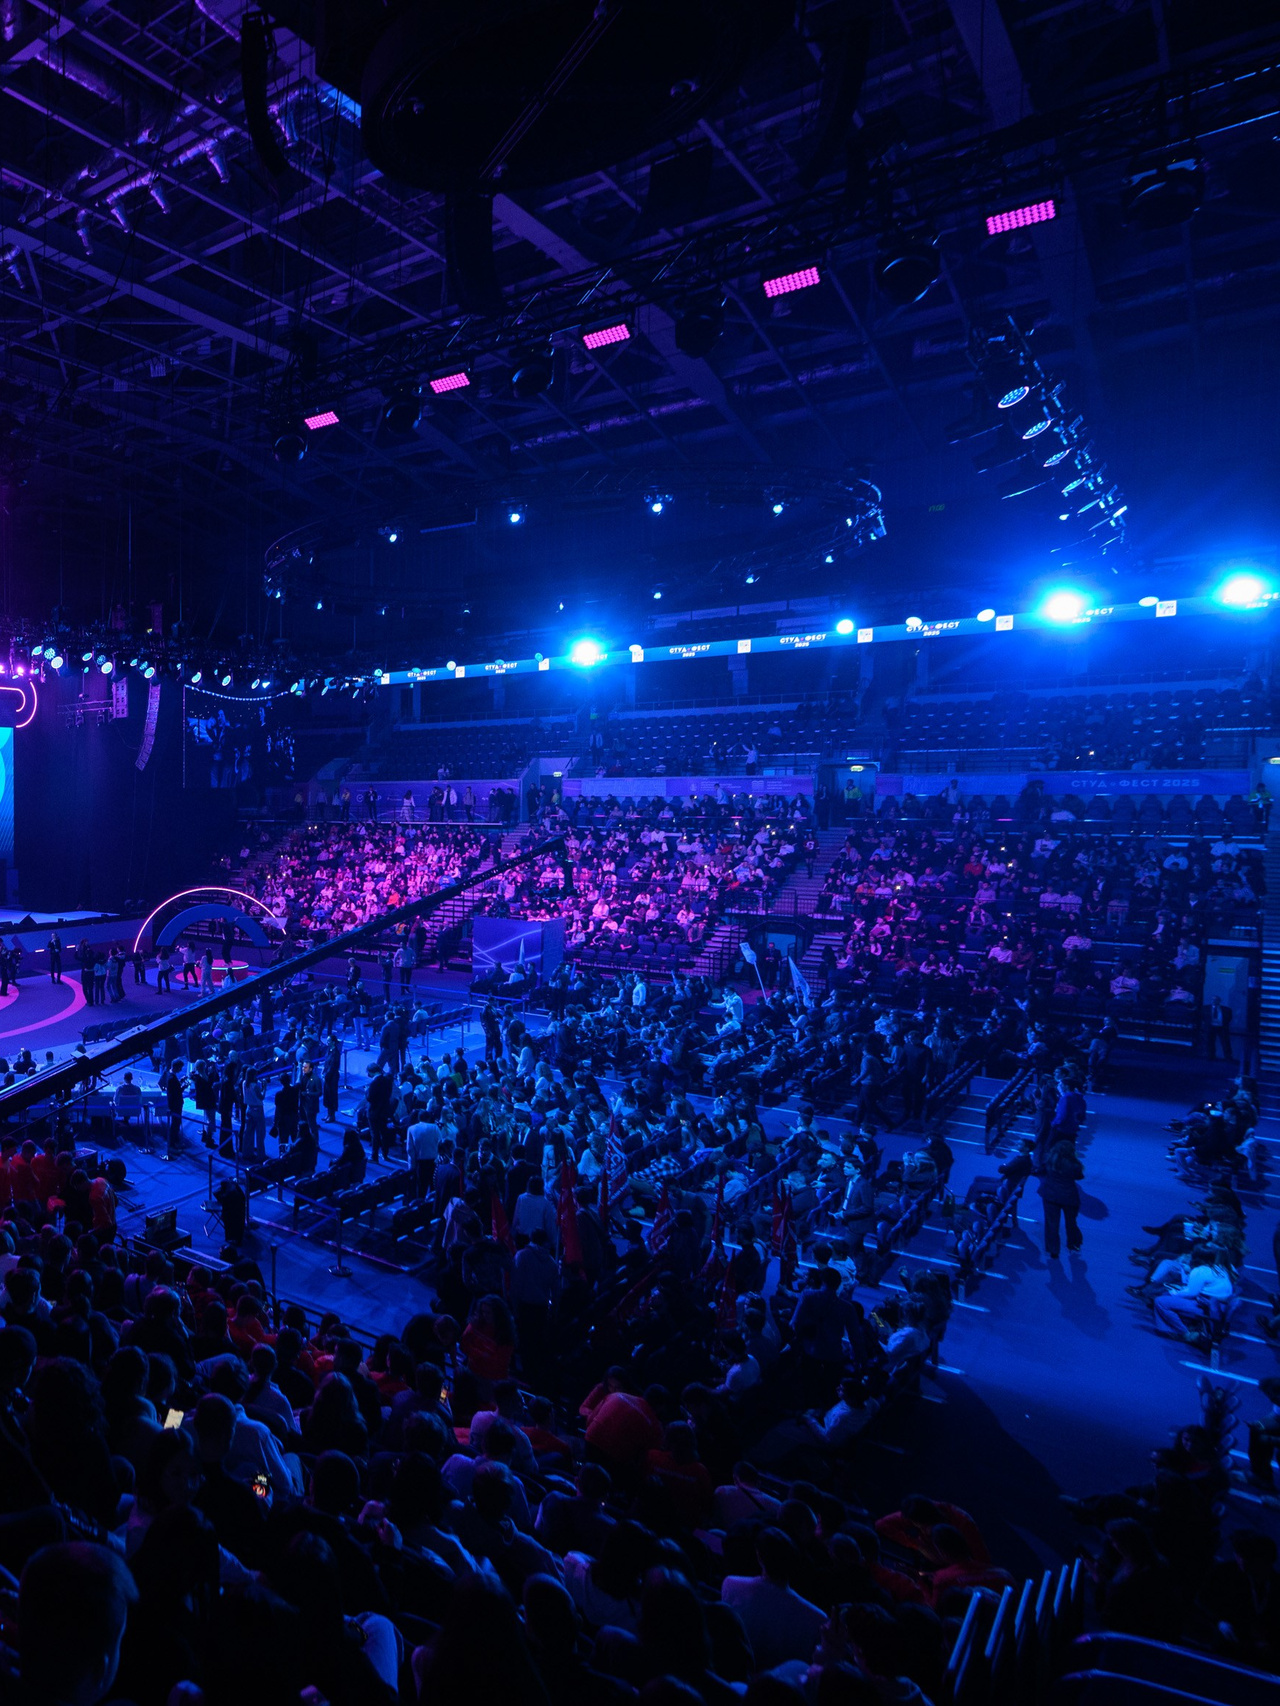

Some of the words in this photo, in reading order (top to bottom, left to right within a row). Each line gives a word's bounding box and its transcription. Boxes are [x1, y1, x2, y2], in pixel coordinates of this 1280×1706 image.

[1071, 779, 1108, 788] СТУД
[1118, 779, 1159, 787] ФЕСТ
[1162, 778, 1200, 787] 2025
